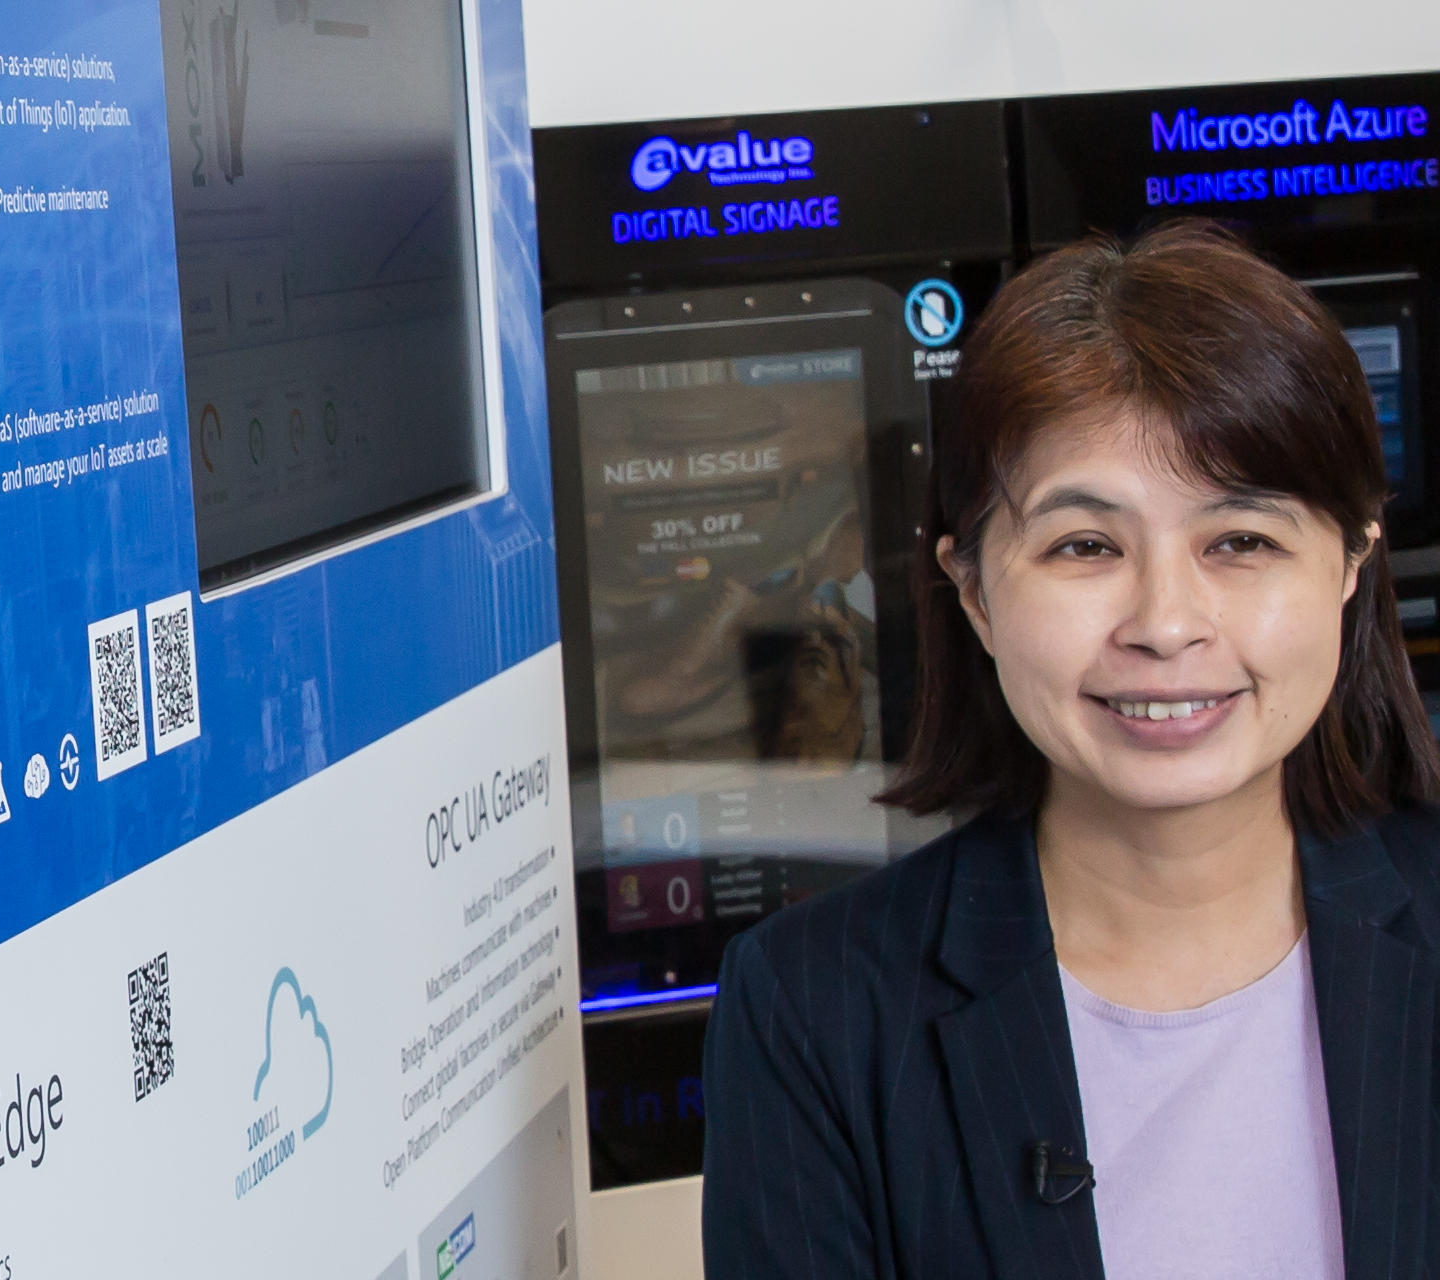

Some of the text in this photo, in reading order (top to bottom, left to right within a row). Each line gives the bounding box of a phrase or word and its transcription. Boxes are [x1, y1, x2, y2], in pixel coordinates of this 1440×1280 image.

[72, 53, 115, 83] solutions,
[6, 97, 17, 124] of
[19, 98, 53, 133] Things
[54, 100, 76, 130] (IoT)
[1151, 98, 1428, 152] Microsoft Azure
[48, 185, 108, 210] maintenance
[1145, 158, 1439, 206] BUSINESS INTELLIGENCE
[612, 196, 839, 244] DIGITAL SIGNAGE
[15, 394, 123, 444] (software-as-a-service)
[124, 389, 158, 417] solution
[2, 461, 22, 491] and
[25, 460, 65, 488] manage
[67, 453, 89, 484] your
[91, 444, 106, 471] IoT
[108, 440, 134, 467] assets
[136, 439, 145, 462] at
[147, 431, 168, 458] scale
[604, 447, 782, 484] NEW ISSUE
[652, 513, 744, 540] 30% OFF
[426, 752, 551, 869] OPC UA Gateway
[401, 1036, 426, 1074] Bridge
[247, 1105, 279, 1152] 100011
[383, 1152, 406, 1190] Open
